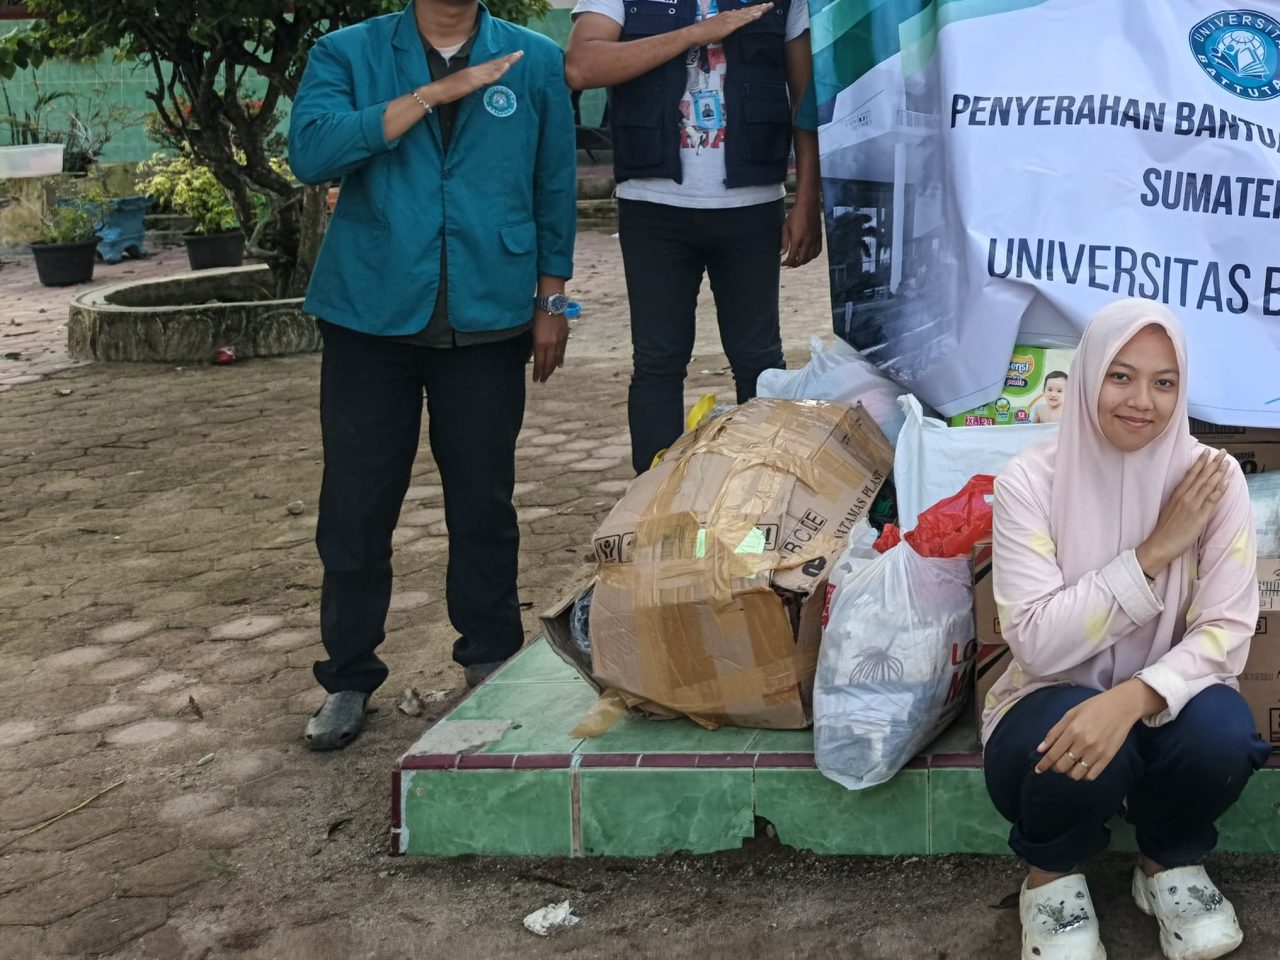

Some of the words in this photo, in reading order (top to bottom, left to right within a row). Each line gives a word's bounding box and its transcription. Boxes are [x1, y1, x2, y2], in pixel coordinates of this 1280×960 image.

[950, 93, 1164, 134] PENYERAHAN
[987, 237, 1249, 315] UNIVERSITAS
[1008, 361, 1029, 375] ensi
[862, 469, 885, 499] PLAST
